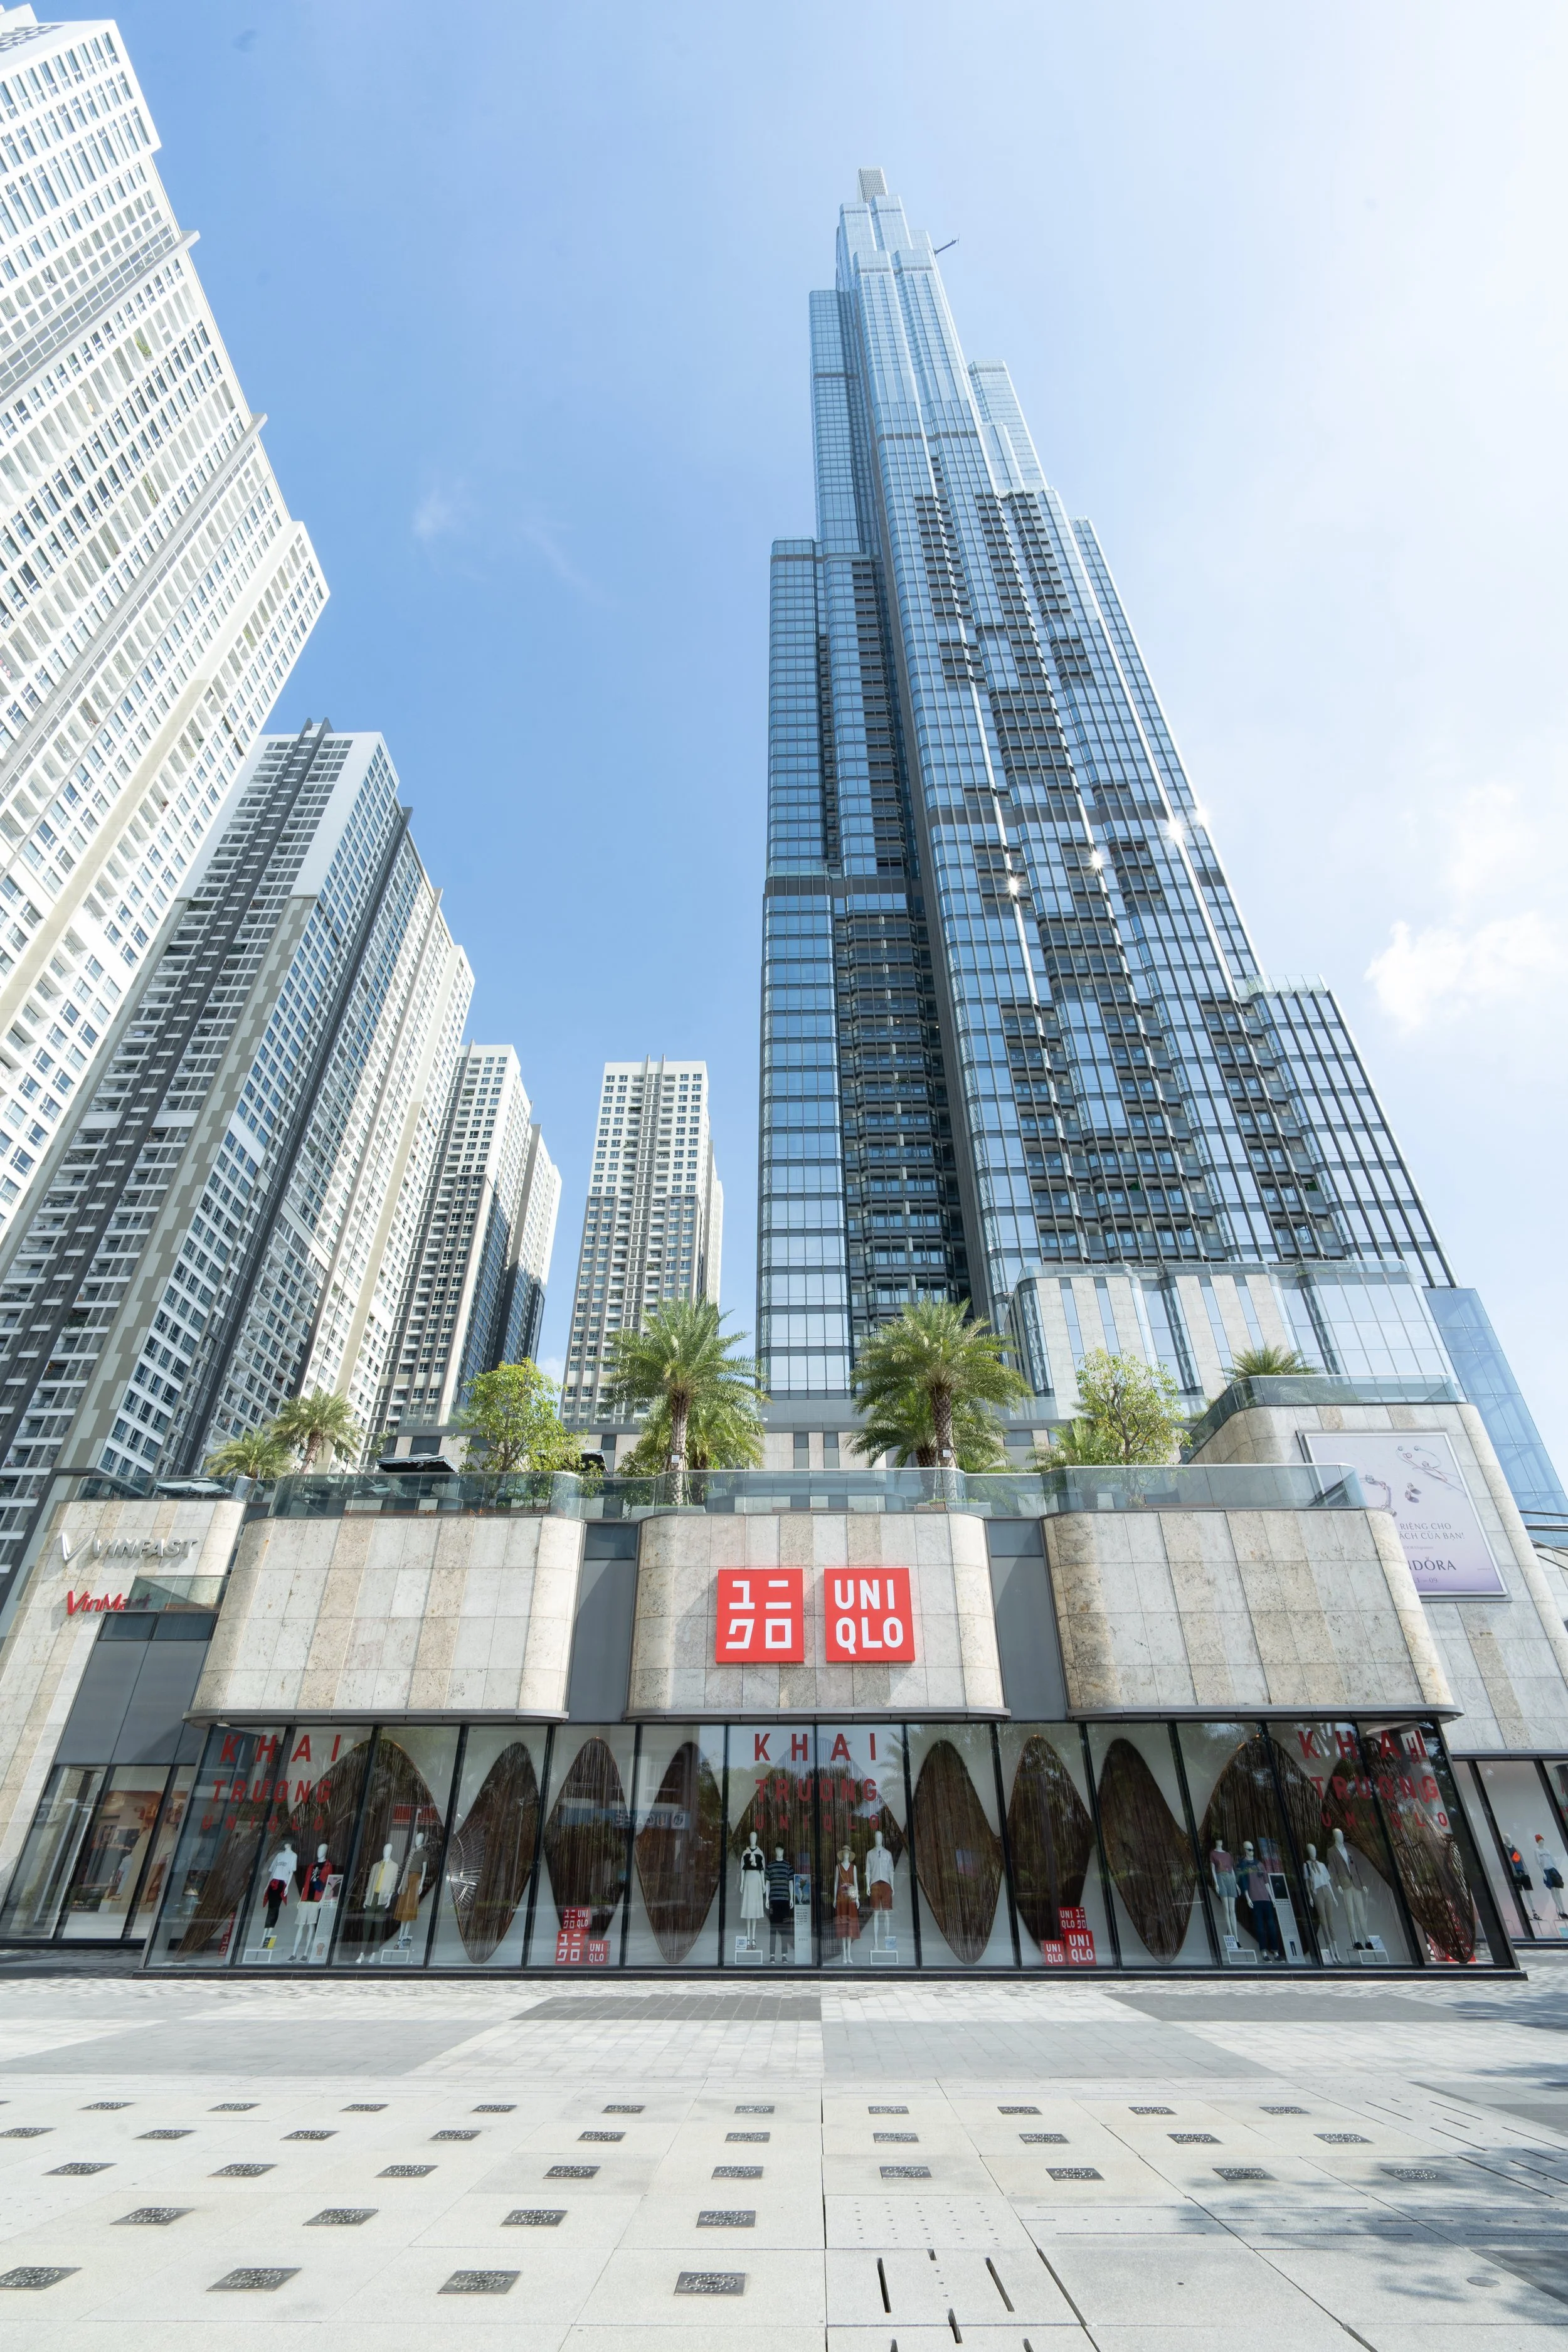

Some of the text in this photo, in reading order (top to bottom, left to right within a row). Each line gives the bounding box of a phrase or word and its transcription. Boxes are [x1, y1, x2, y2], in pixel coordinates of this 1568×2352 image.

[93, 1538, 199, 1559] VINFAST
[834, 1579, 895, 1610] UNI
[66, 1589, 152, 1616] VinMart
[835, 1617, 904, 1655] QLO
[220, 1734, 341, 1762] KHAI
[755, 1733, 876, 1761] KHAI
[202, 1815, 324, 1834] UNIQLO
[755, 1814, 879, 1833] UNIQLO
[578, 1909, 588, 1918] UNI
[1060, 1910, 1073, 1919] UNI
[576, 1919, 588, 1929] QLO
[1061, 1920, 1075, 1930] QLO
[590, 1943, 604, 1952] UNI
[1069, 1934, 1090, 1947] UNI
[1046, 1944, 1061, 1952] UNI
[589, 1953, 605, 1963] QLO
[1047, 1954, 1063, 1964] QLO
[1071, 1948, 1093, 1963] QLO
